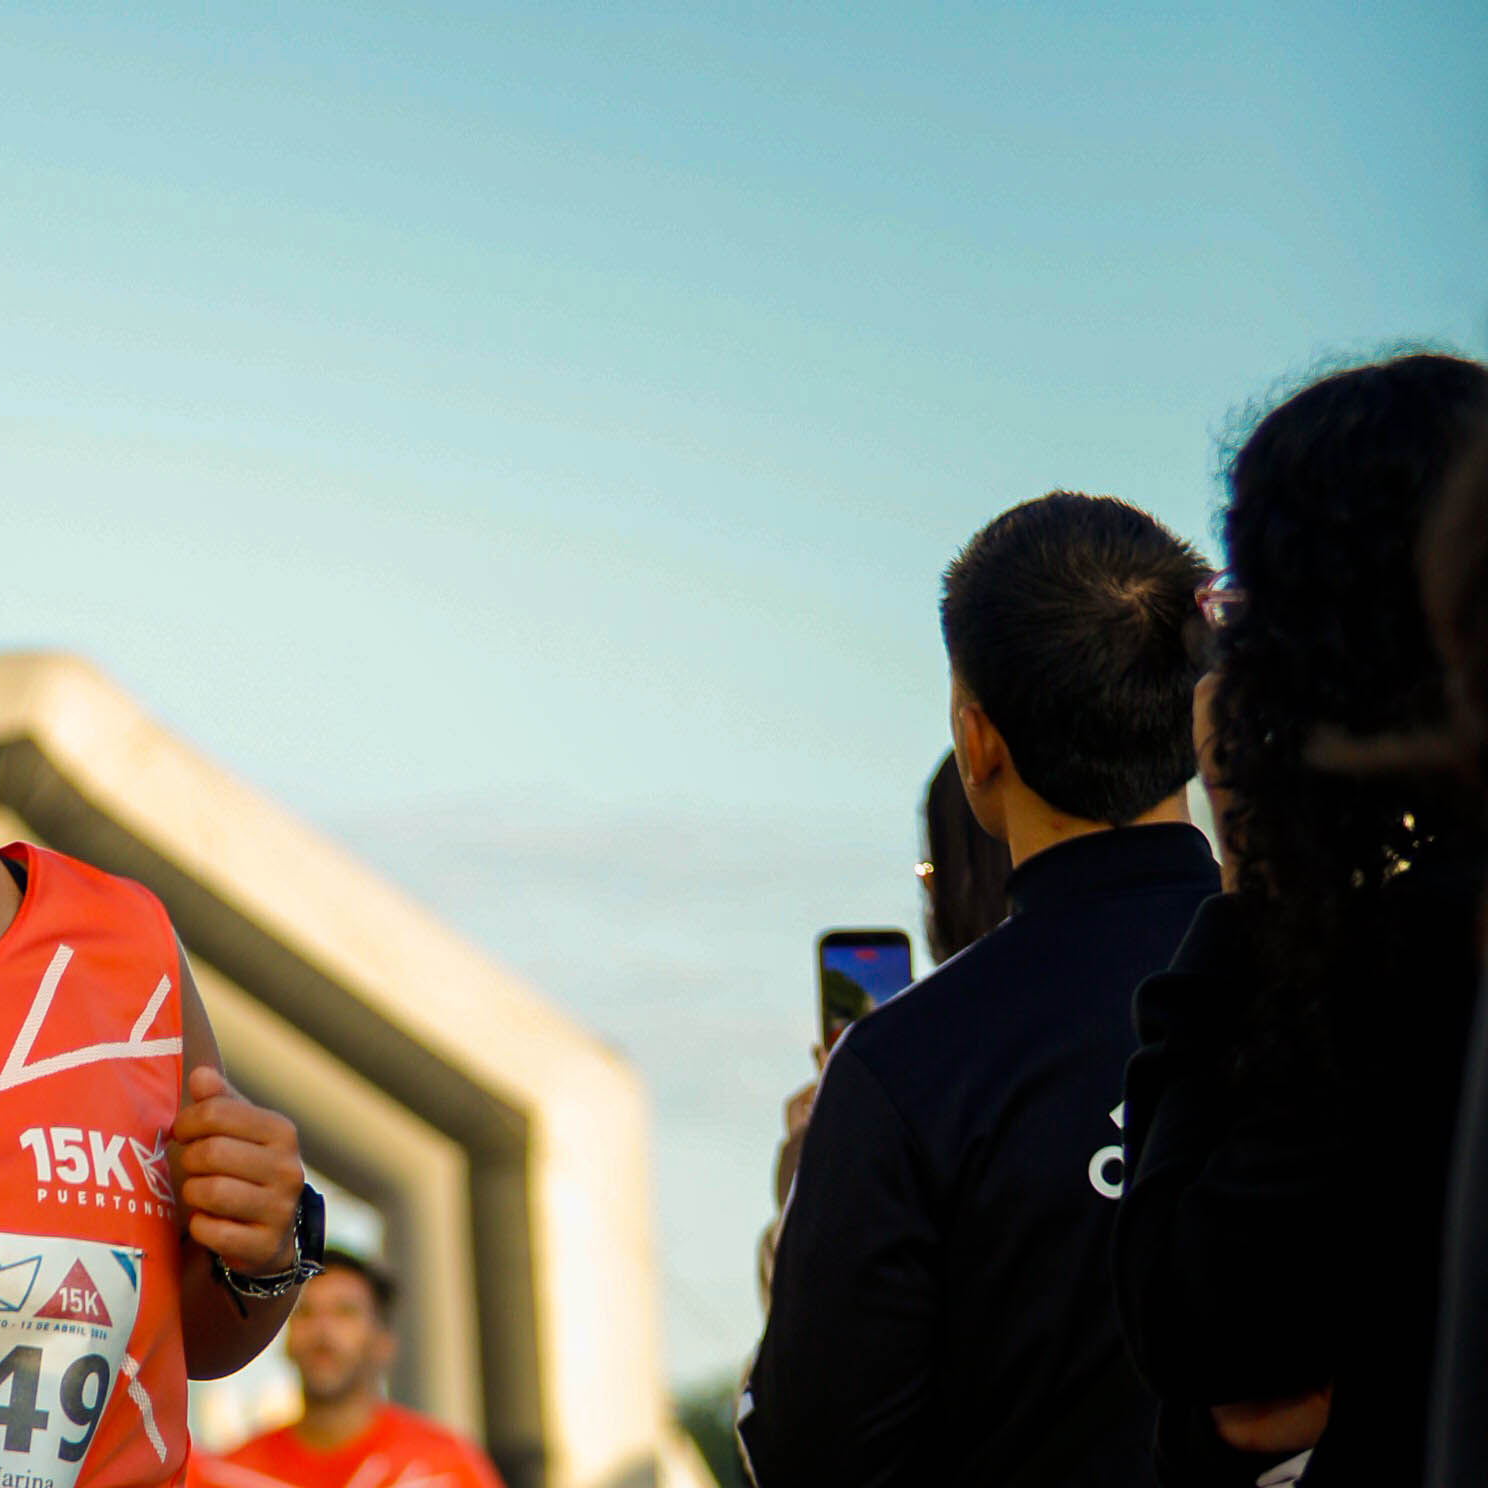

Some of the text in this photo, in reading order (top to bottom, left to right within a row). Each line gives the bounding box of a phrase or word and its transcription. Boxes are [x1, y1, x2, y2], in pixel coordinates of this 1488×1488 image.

[19, 1127, 135, 1191] 15K
[37, 1188, 136, 1212] PUERTO
[58, 1286, 99, 1316] 15K
[36, 1322, 49, 1331] DE
[53, 1324, 86, 1336] ABRIL
